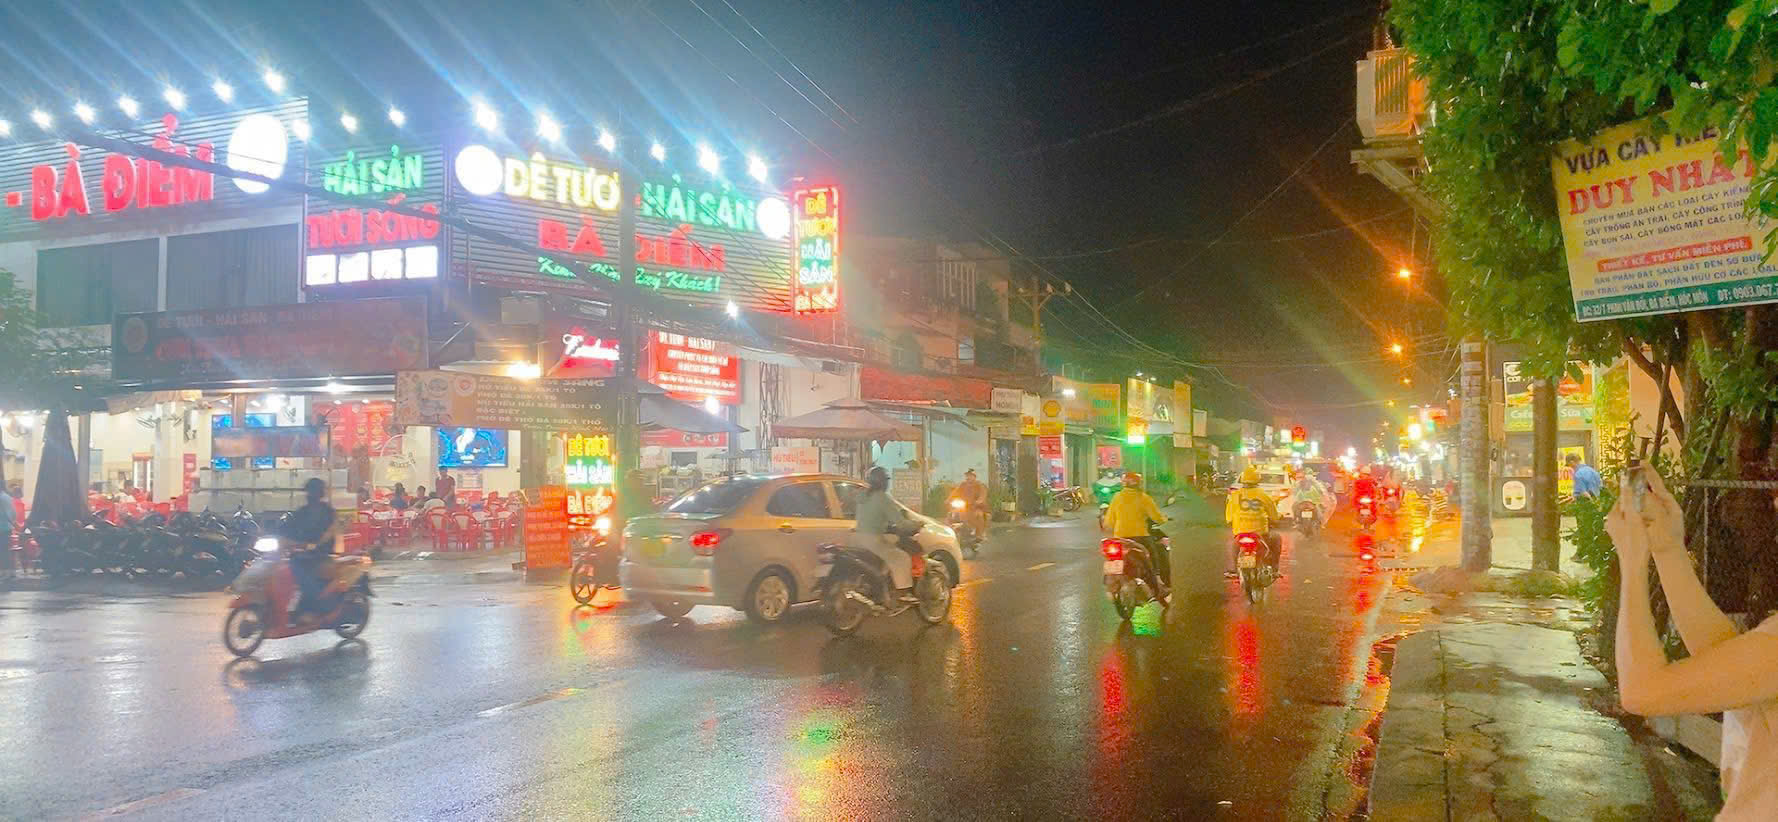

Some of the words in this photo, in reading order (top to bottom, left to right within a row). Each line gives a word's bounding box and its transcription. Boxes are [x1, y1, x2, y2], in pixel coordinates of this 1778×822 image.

[31, 142, 90, 221] BÀ
[103, 113, 214, 212] ĐIỂM
[323, 150, 369, 196] HẢI
[370, 144, 424, 193] SẢN
[503, 151, 549, 201] DÊ
[640, 173, 696, 223] HẢI
[697, 181, 755, 232] SẢN
[307, 207, 363, 249] TƯƠI
[366, 192, 440, 245] SỐNG
[1568, 176, 1639, 216] DUY
[538, 211, 607, 258] BÀ
